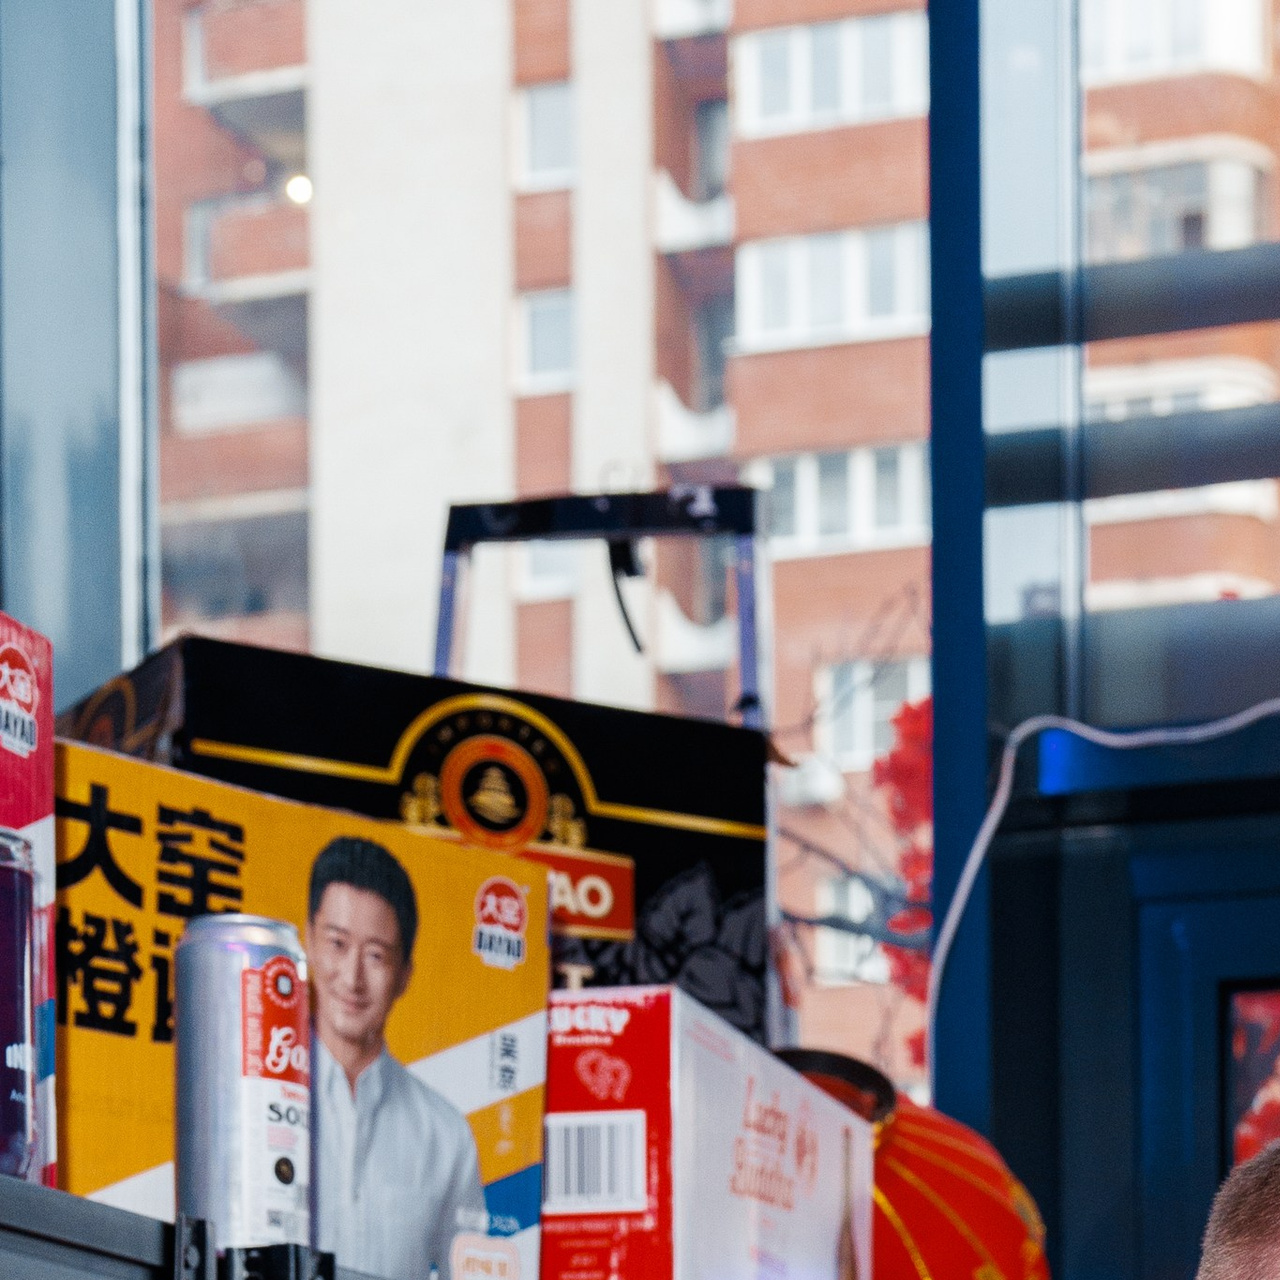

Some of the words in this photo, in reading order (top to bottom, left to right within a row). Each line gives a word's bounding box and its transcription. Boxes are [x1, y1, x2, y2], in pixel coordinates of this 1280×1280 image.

[551, 870, 615, 919] AO
[56, 907, 178, 1042] 橙
[550, 1005, 631, 1036] UCKY
